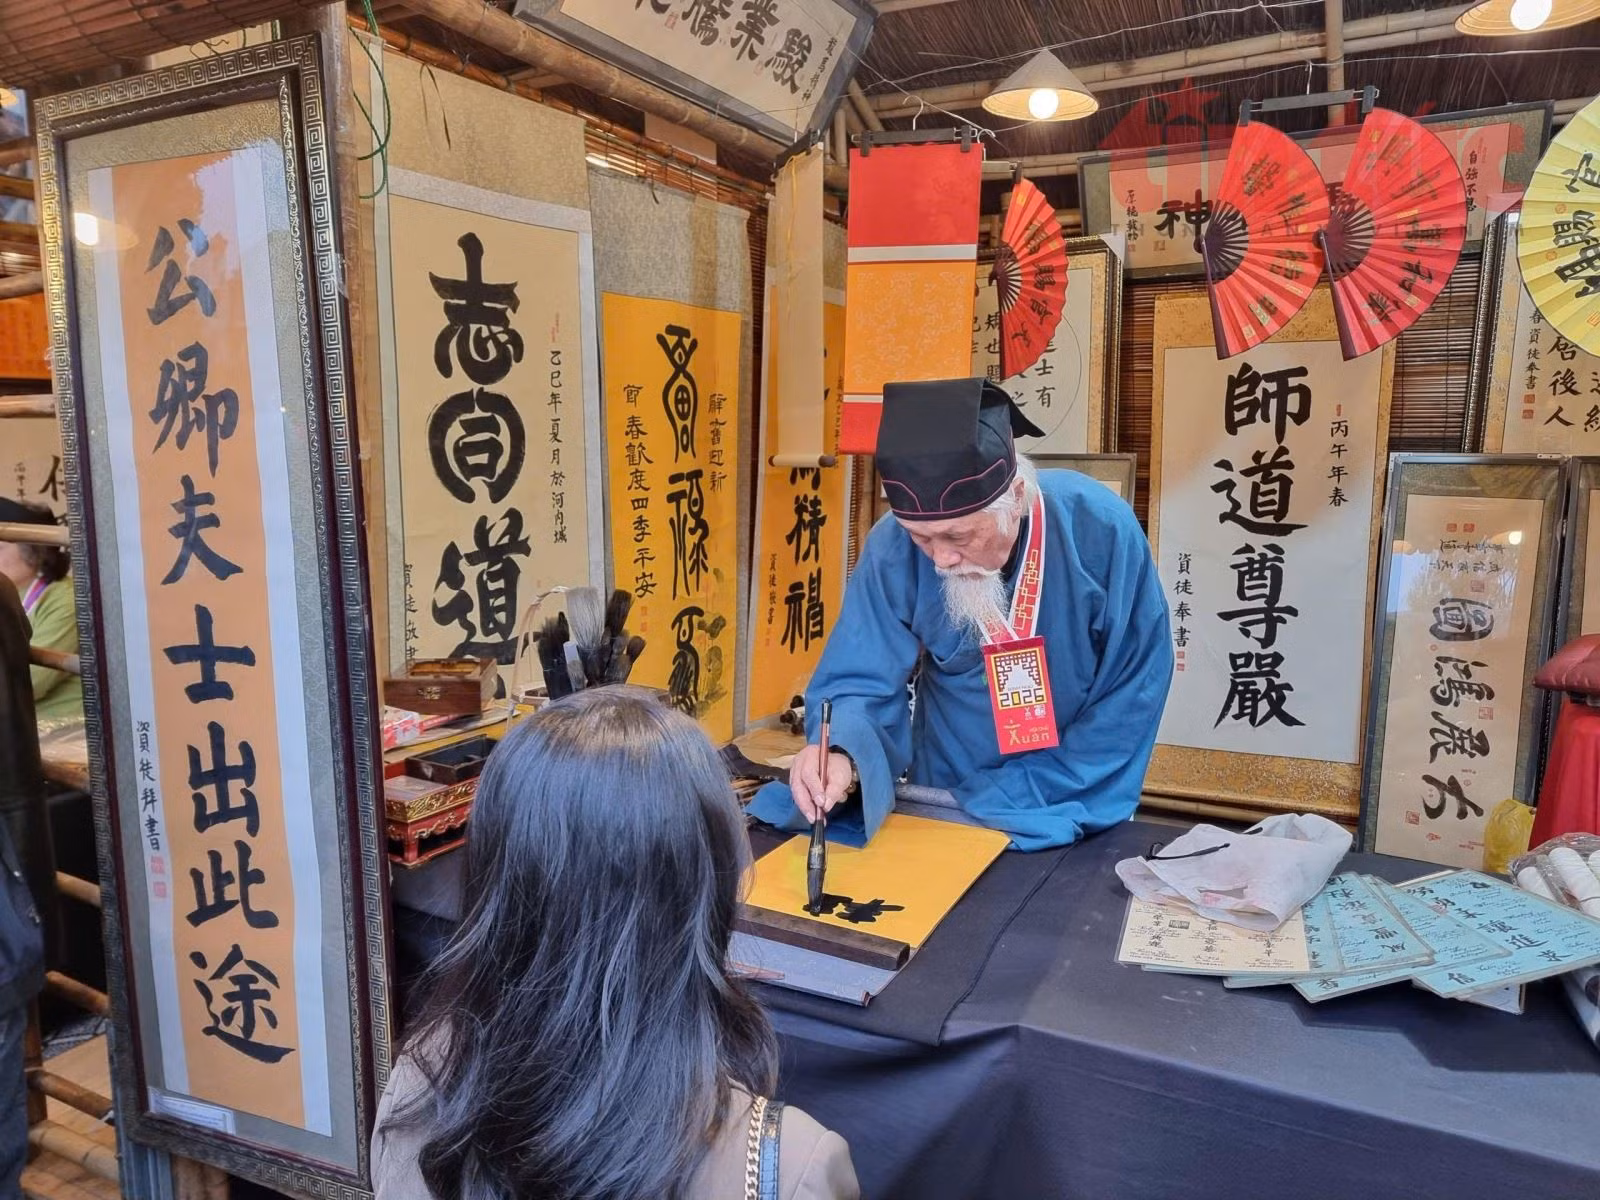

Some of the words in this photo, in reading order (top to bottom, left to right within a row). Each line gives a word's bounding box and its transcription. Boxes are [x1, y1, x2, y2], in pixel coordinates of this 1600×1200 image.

[634, 0, 813, 95] 駿業騰
[1327, 420, 1349, 508] 丙午年春
[1210, 362, 1309, 729] 師道尊嚴
[145, 217, 296, 1065] 公卿夫士出此途
[1172, 553, 1194, 648] 資徒奉書
[999, 688, 1046, 708] 2026
